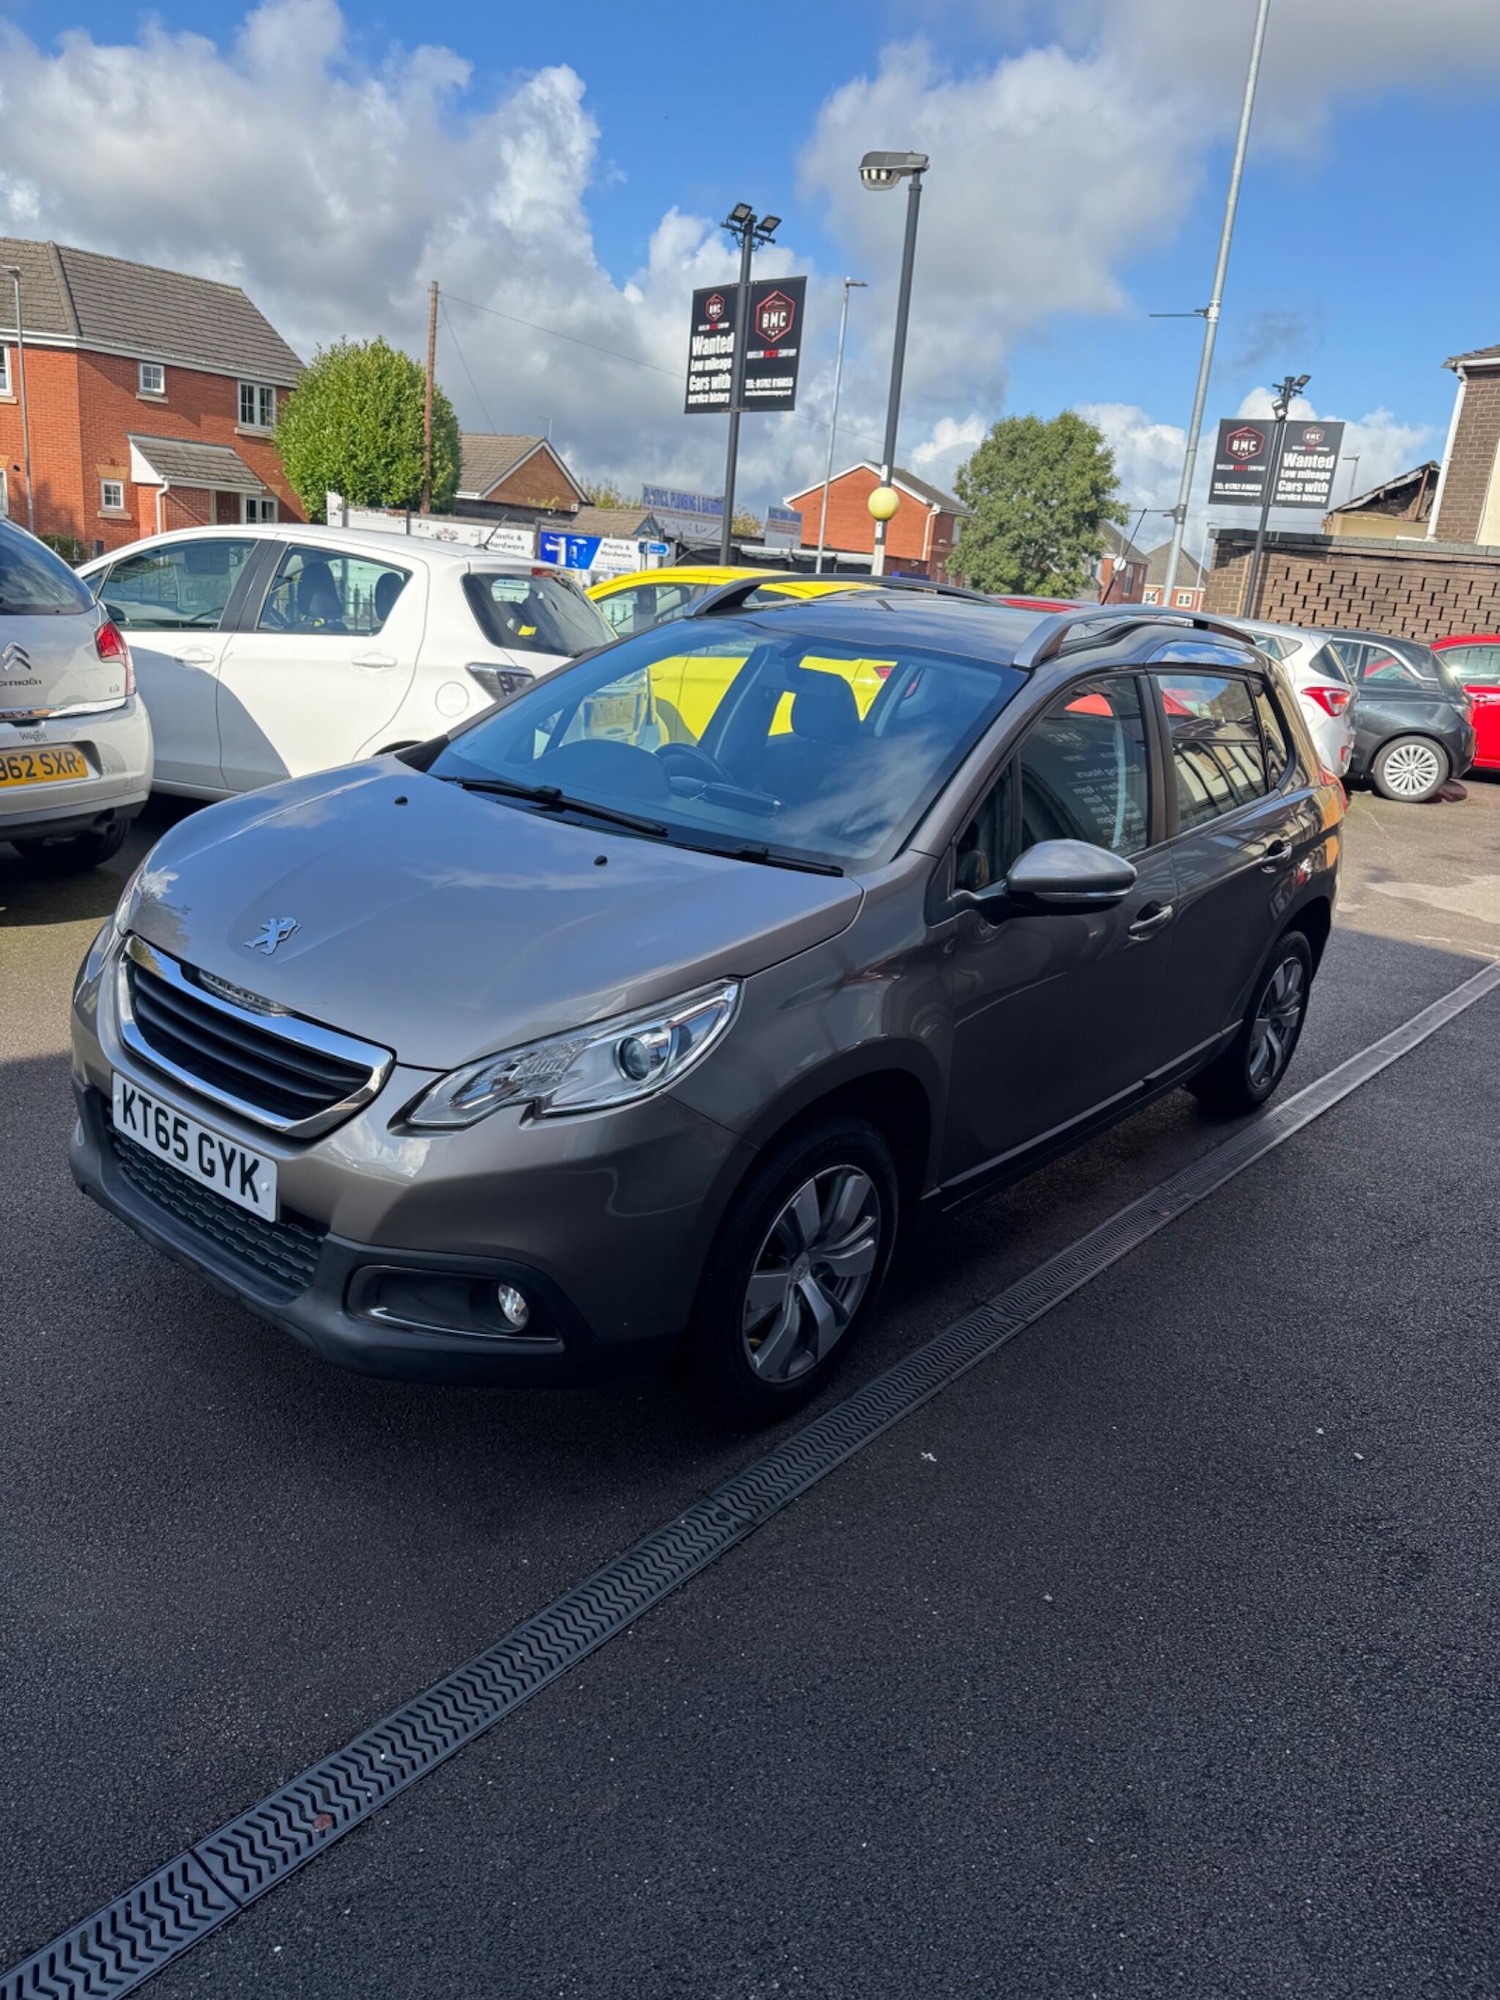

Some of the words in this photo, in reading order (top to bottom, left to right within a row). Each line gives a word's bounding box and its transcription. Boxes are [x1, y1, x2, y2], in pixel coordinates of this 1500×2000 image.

[762, 312, 787, 328] BMC
[692, 332, 735, 356] Wanted
[690, 359, 704, 372] Low
[704, 357, 732, 370] mileage
[689, 375, 710, 391] Cars
[711, 373, 732, 390] with
[688, 393, 708, 404] service
[709, 392, 730, 404] history
[1306, 433, 1321, 441] BMC
[1233, 440, 1257, 451] BMC
[1283, 452, 1335, 469] Wanted
[1280, 468, 1297, 478] Low
[1297, 469, 1331, 481] mileage
[1278, 480, 1303, 492] Cars
[1305, 481, 1329, 493] with
[1276, 492, 1301, 501] service
[1302, 493, 1327, 503] history
[603, 542, 623, 550] Plastic
[600, 550, 632, 558] Hardware
[39, 751, 79, 775] SXR
[122, 1083, 190, 1162] KT65
[198, 1131, 260, 1203] GYK
